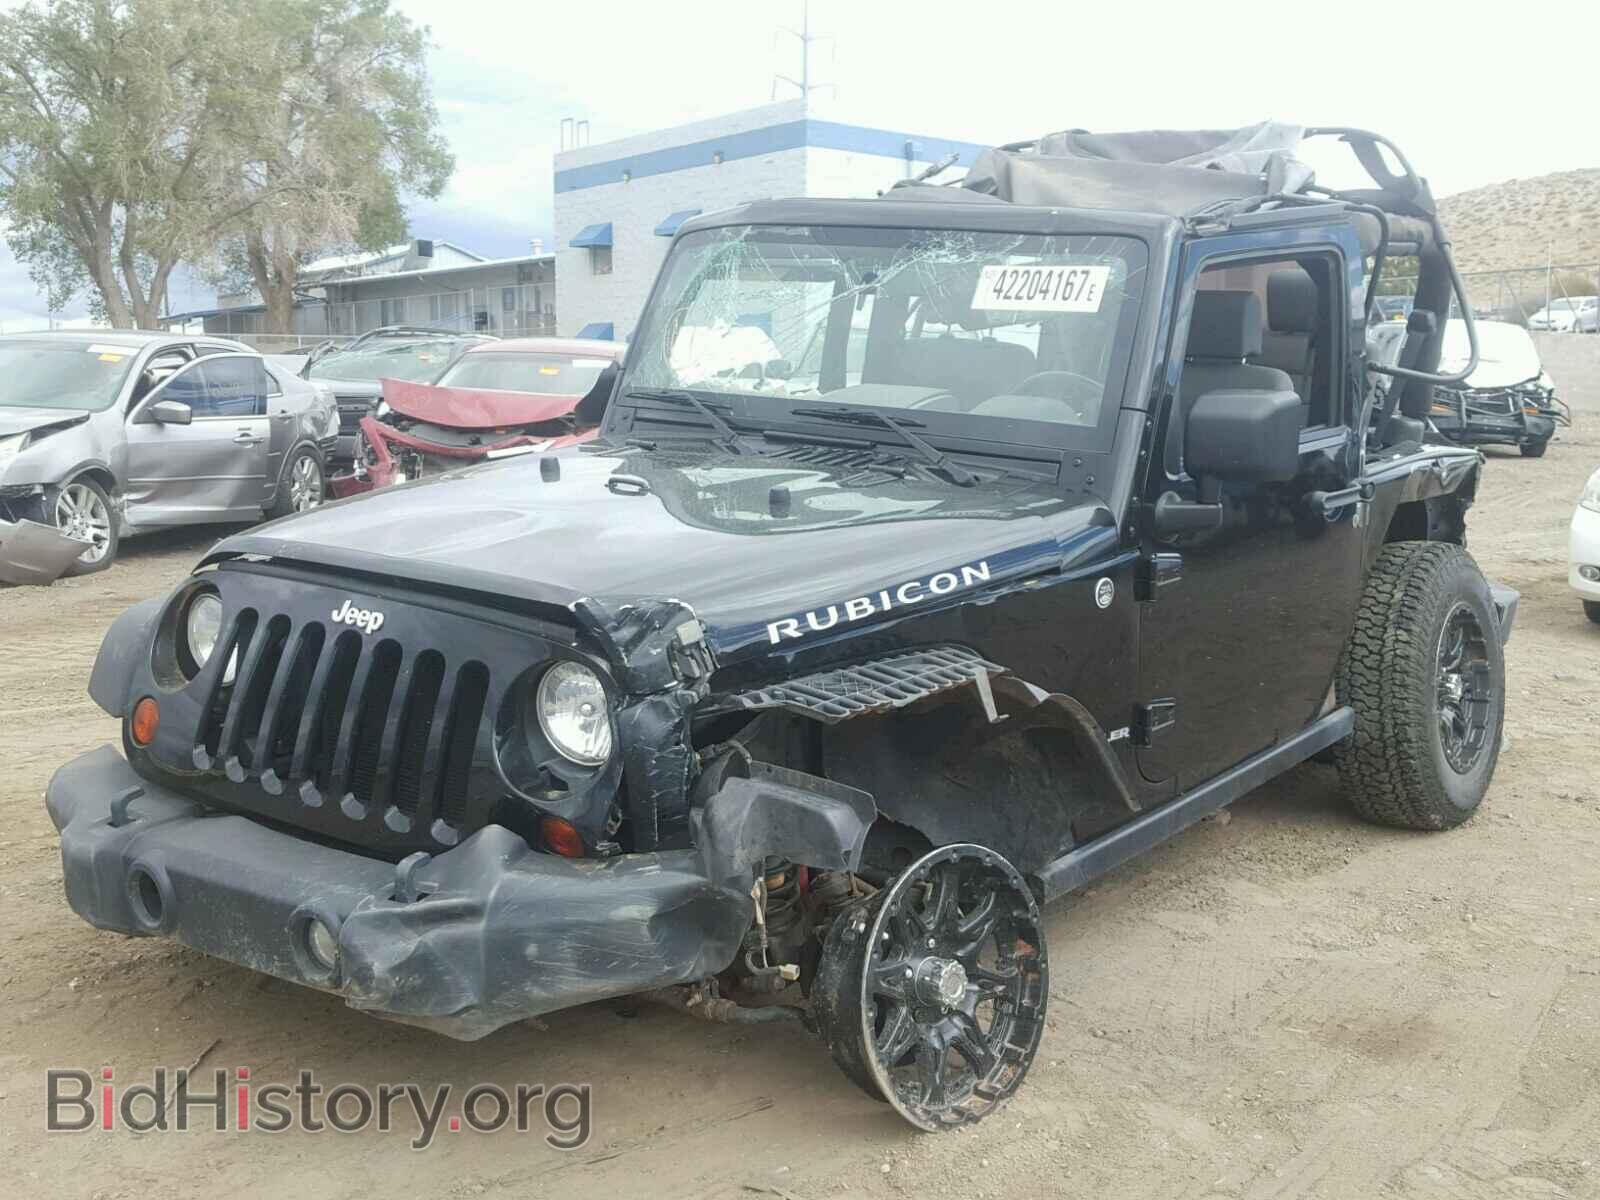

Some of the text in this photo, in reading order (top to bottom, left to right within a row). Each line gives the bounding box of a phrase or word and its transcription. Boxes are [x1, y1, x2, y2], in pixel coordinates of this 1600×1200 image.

[992, 269, 1090, 301] 42204167
[331, 599, 385, 634] Jeep
[767, 561, 991, 644] RUBICON
